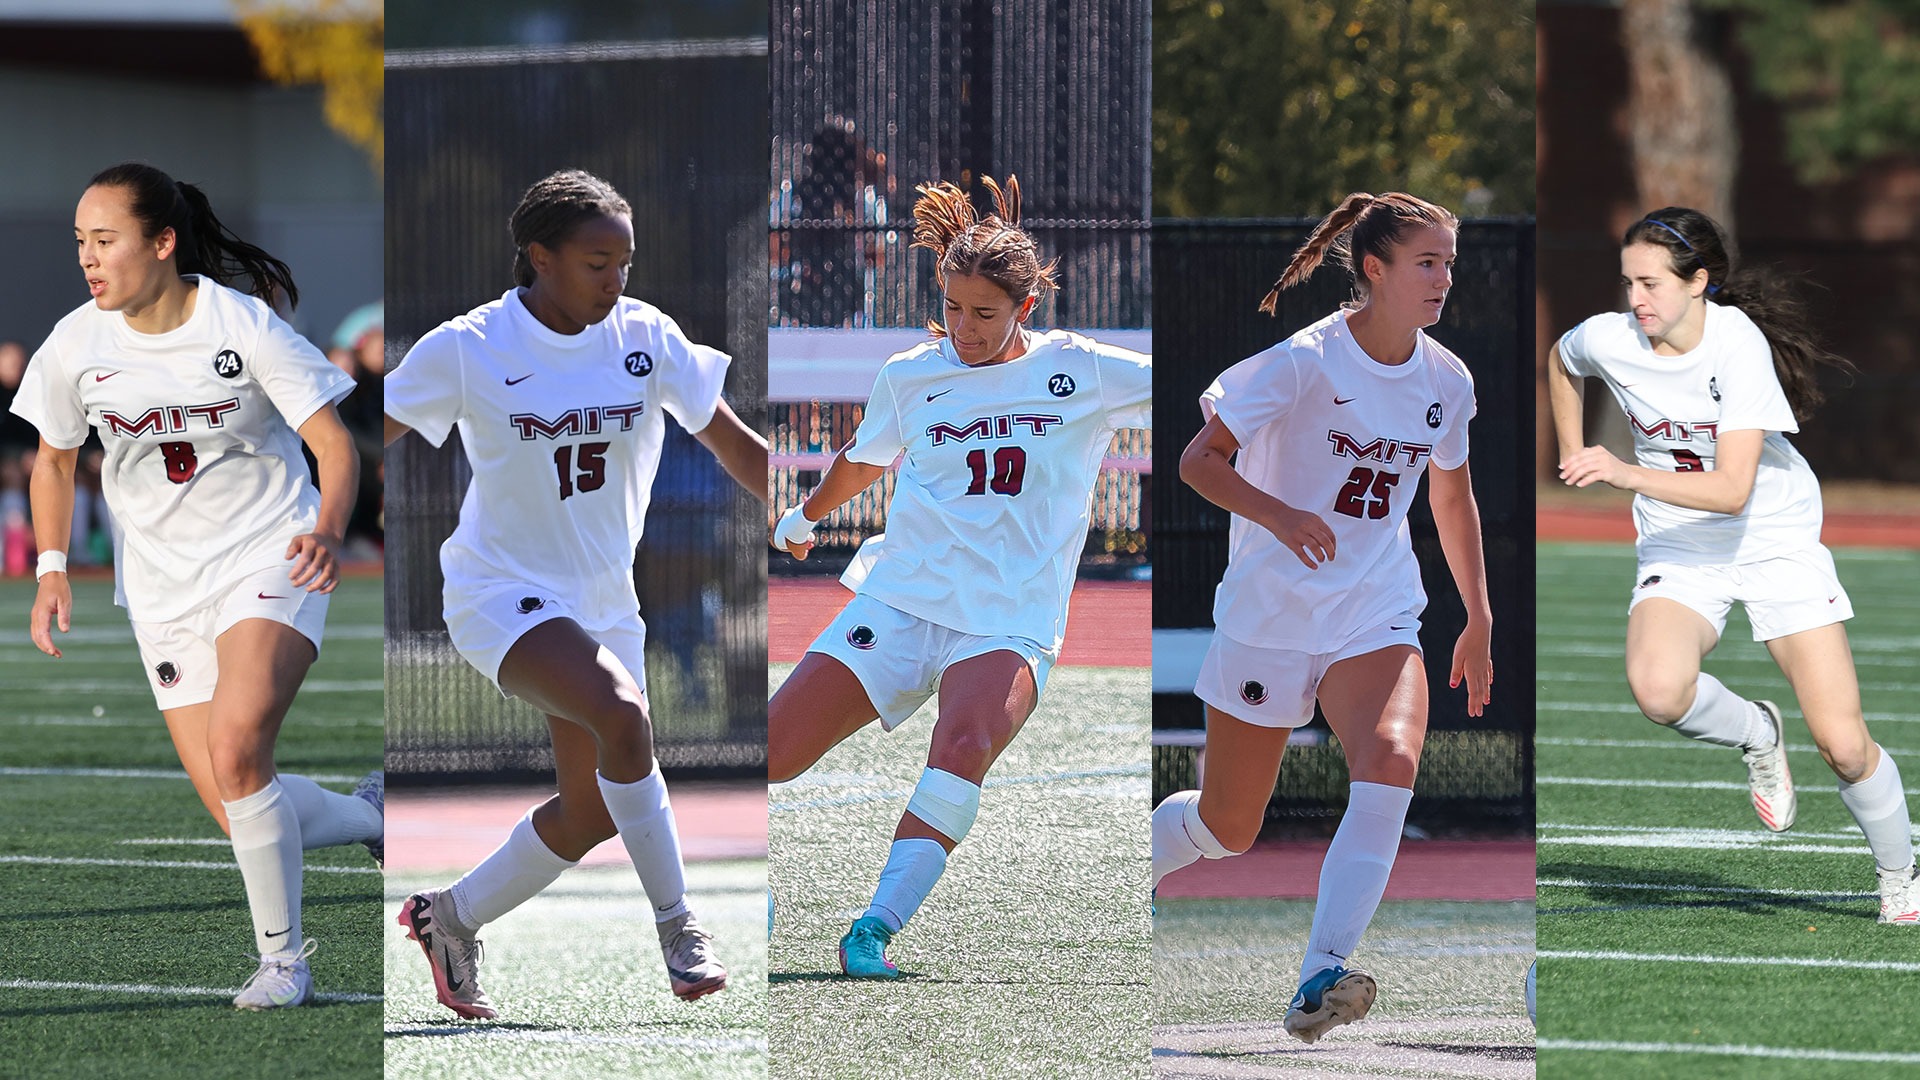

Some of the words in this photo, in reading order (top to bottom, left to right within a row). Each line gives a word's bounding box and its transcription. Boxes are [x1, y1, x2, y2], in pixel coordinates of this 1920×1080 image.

[217, 353, 240, 375] 24
[627, 354, 650, 374] 24
[1051, 376, 1073, 394] 24
[100, 397, 240, 438] MIT
[509, 401, 644, 441] MIT
[926, 413, 1063, 447] MIT
[1429, 406, 1441, 424] 24
[1624, 405, 1719, 443] MIT
[158, 441, 198, 484] 8
[1327, 429, 1432, 467] MIT
[554, 441, 611, 501] 15
[965, 446, 1026, 497] 10
[1333, 466, 1400, 520] 25
